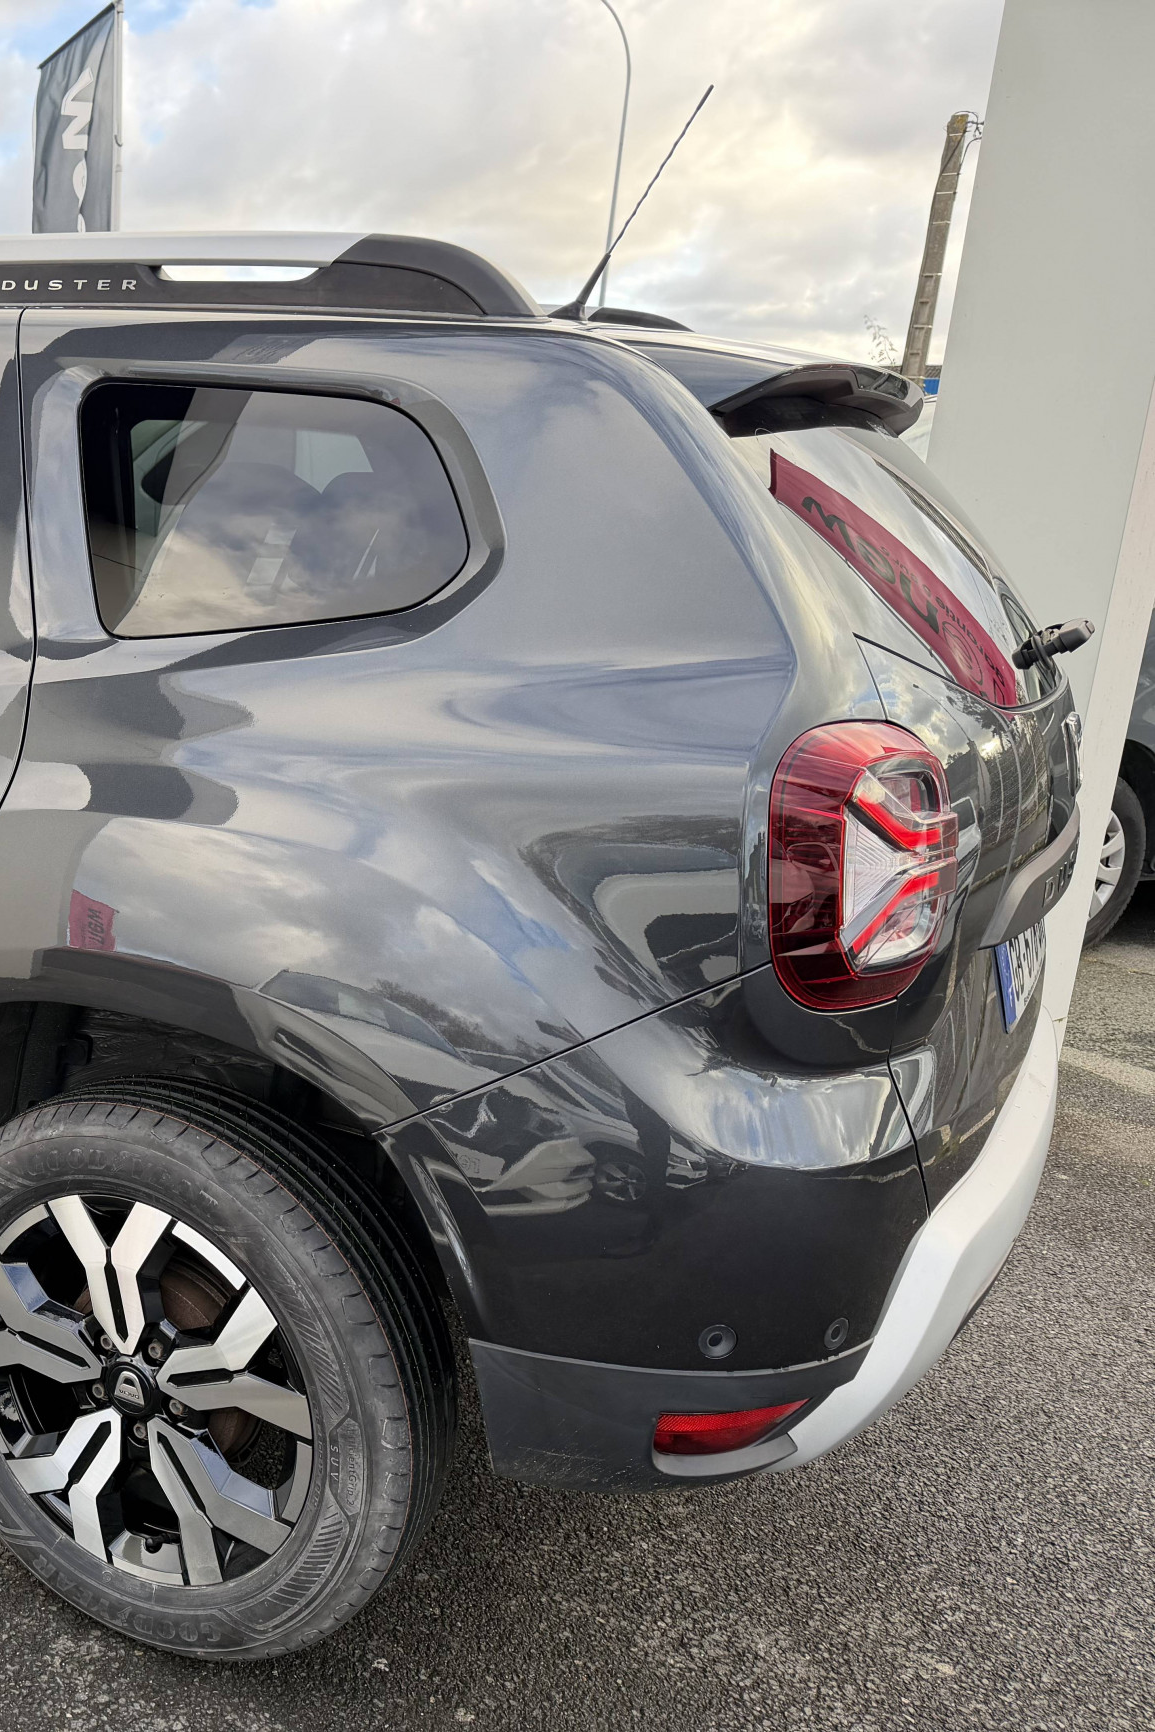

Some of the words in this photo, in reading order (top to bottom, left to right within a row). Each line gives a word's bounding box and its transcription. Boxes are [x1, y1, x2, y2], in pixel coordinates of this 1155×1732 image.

[1, 279, 137, 291] DUSTER
[1042, 837, 1081, 908] DUS
[330, 1444, 339, 1482] SUV
